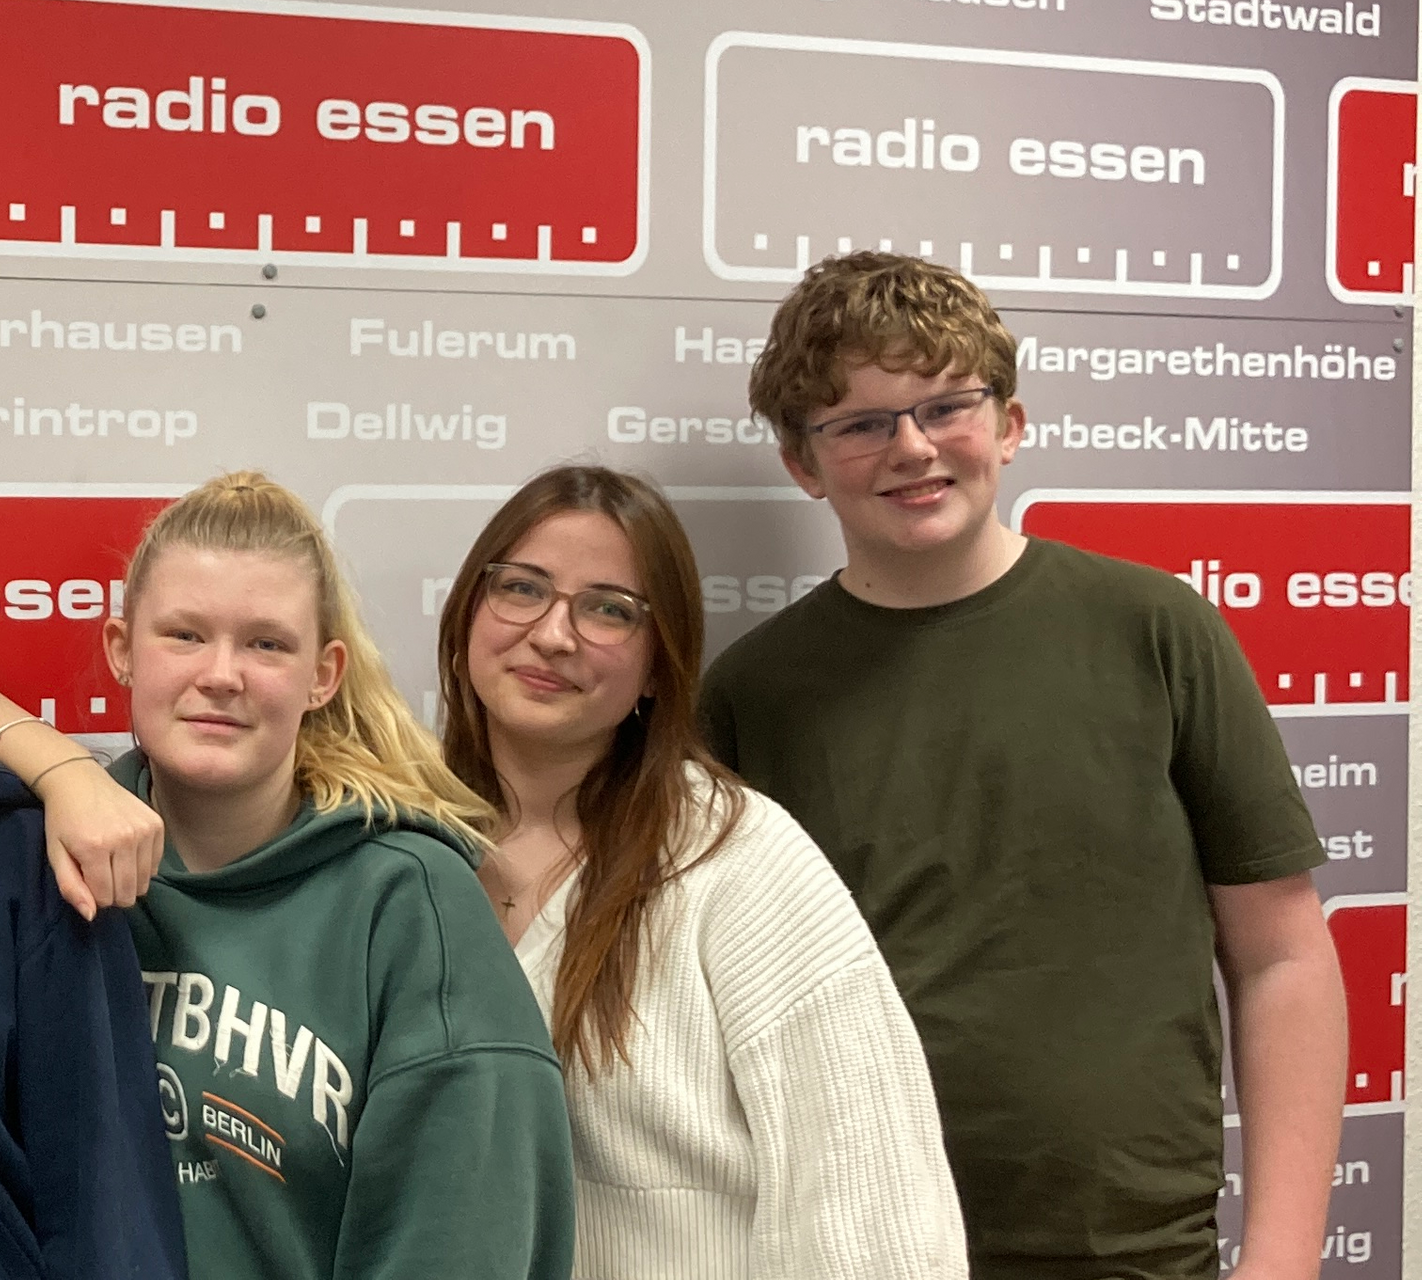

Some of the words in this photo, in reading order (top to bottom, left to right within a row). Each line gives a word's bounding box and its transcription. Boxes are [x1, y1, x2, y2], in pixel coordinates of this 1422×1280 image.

[59, 76, 281, 137] radio
[316, 98, 555, 150] essen
[796, 119, 981, 172] radio
[1009, 138, 1205, 184] essen
[350, 318, 576, 360] Fulerum
[307, 402, 507, 449] Dellwig
[1019, 415, 1308, 452] orbeck-Mitte
[141, 970, 353, 1150] TBHVR
[202, 1104, 281, 1167] BERLIN
